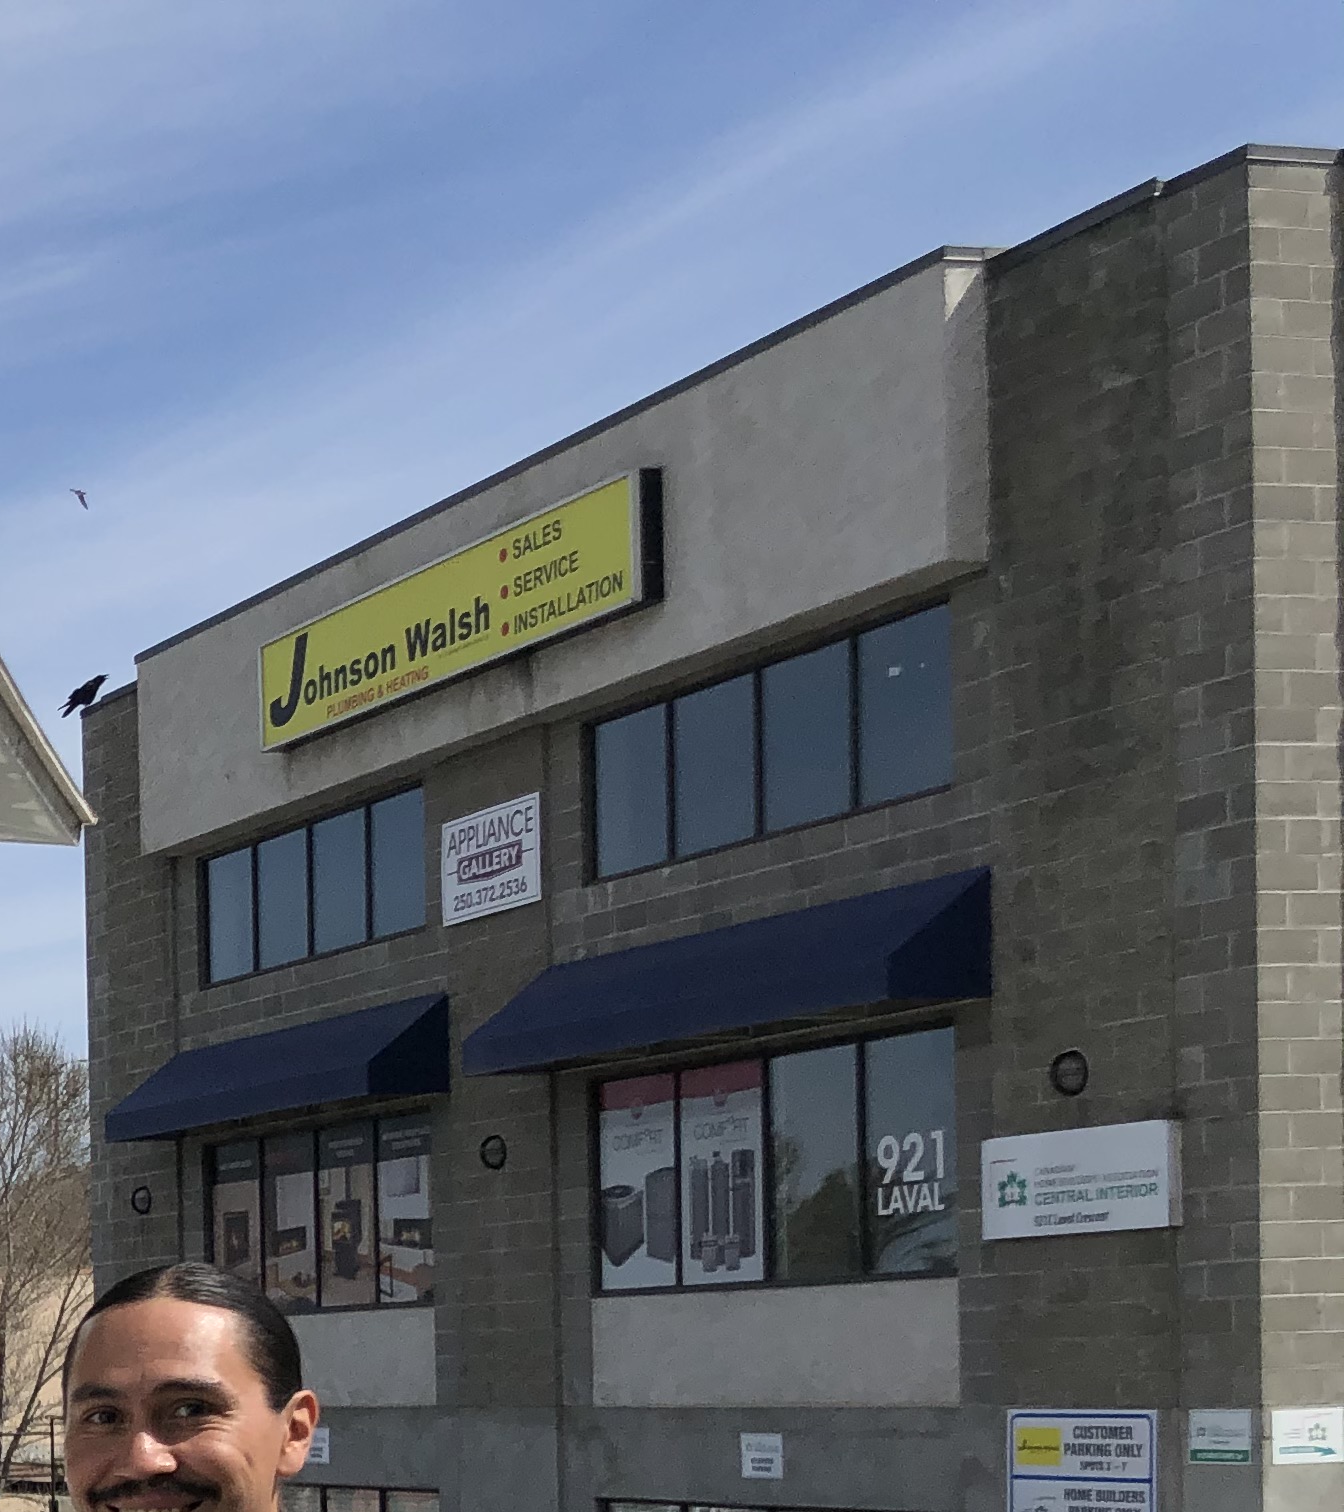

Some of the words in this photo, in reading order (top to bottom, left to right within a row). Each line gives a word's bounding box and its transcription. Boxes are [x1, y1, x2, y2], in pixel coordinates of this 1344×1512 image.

[512, 519, 562, 560] SALES
[513, 550, 580, 598] SERVICE
[513, 571, 624, 635] INSTALLATION
[269, 632, 396, 728] Johnson
[405, 595, 490, 662] Walsh
[326, 687, 375, 719] PLUMBING
[386, 665, 430, 693] HEATING
[446, 805, 534, 859] APPLIANCE
[459, 844, 519, 880] GALLERY
[876, 1130, 946, 1185] 921
[876, 1182, 946, 1216] LAVAL
[1034, 1188, 1094, 1206] CENTRAL
[1096, 1182, 1159, 1200] INTERIOR
[1063, 1442, 1112, 1457] PARKING
[1114, 1443, 1143, 1458] ONLY
[1072, 1425, 1133, 1440] CUSTOMER
[1063, 1488, 1092, 1501] HOME
[1095, 1489, 1146, 1504] BUILDERS
